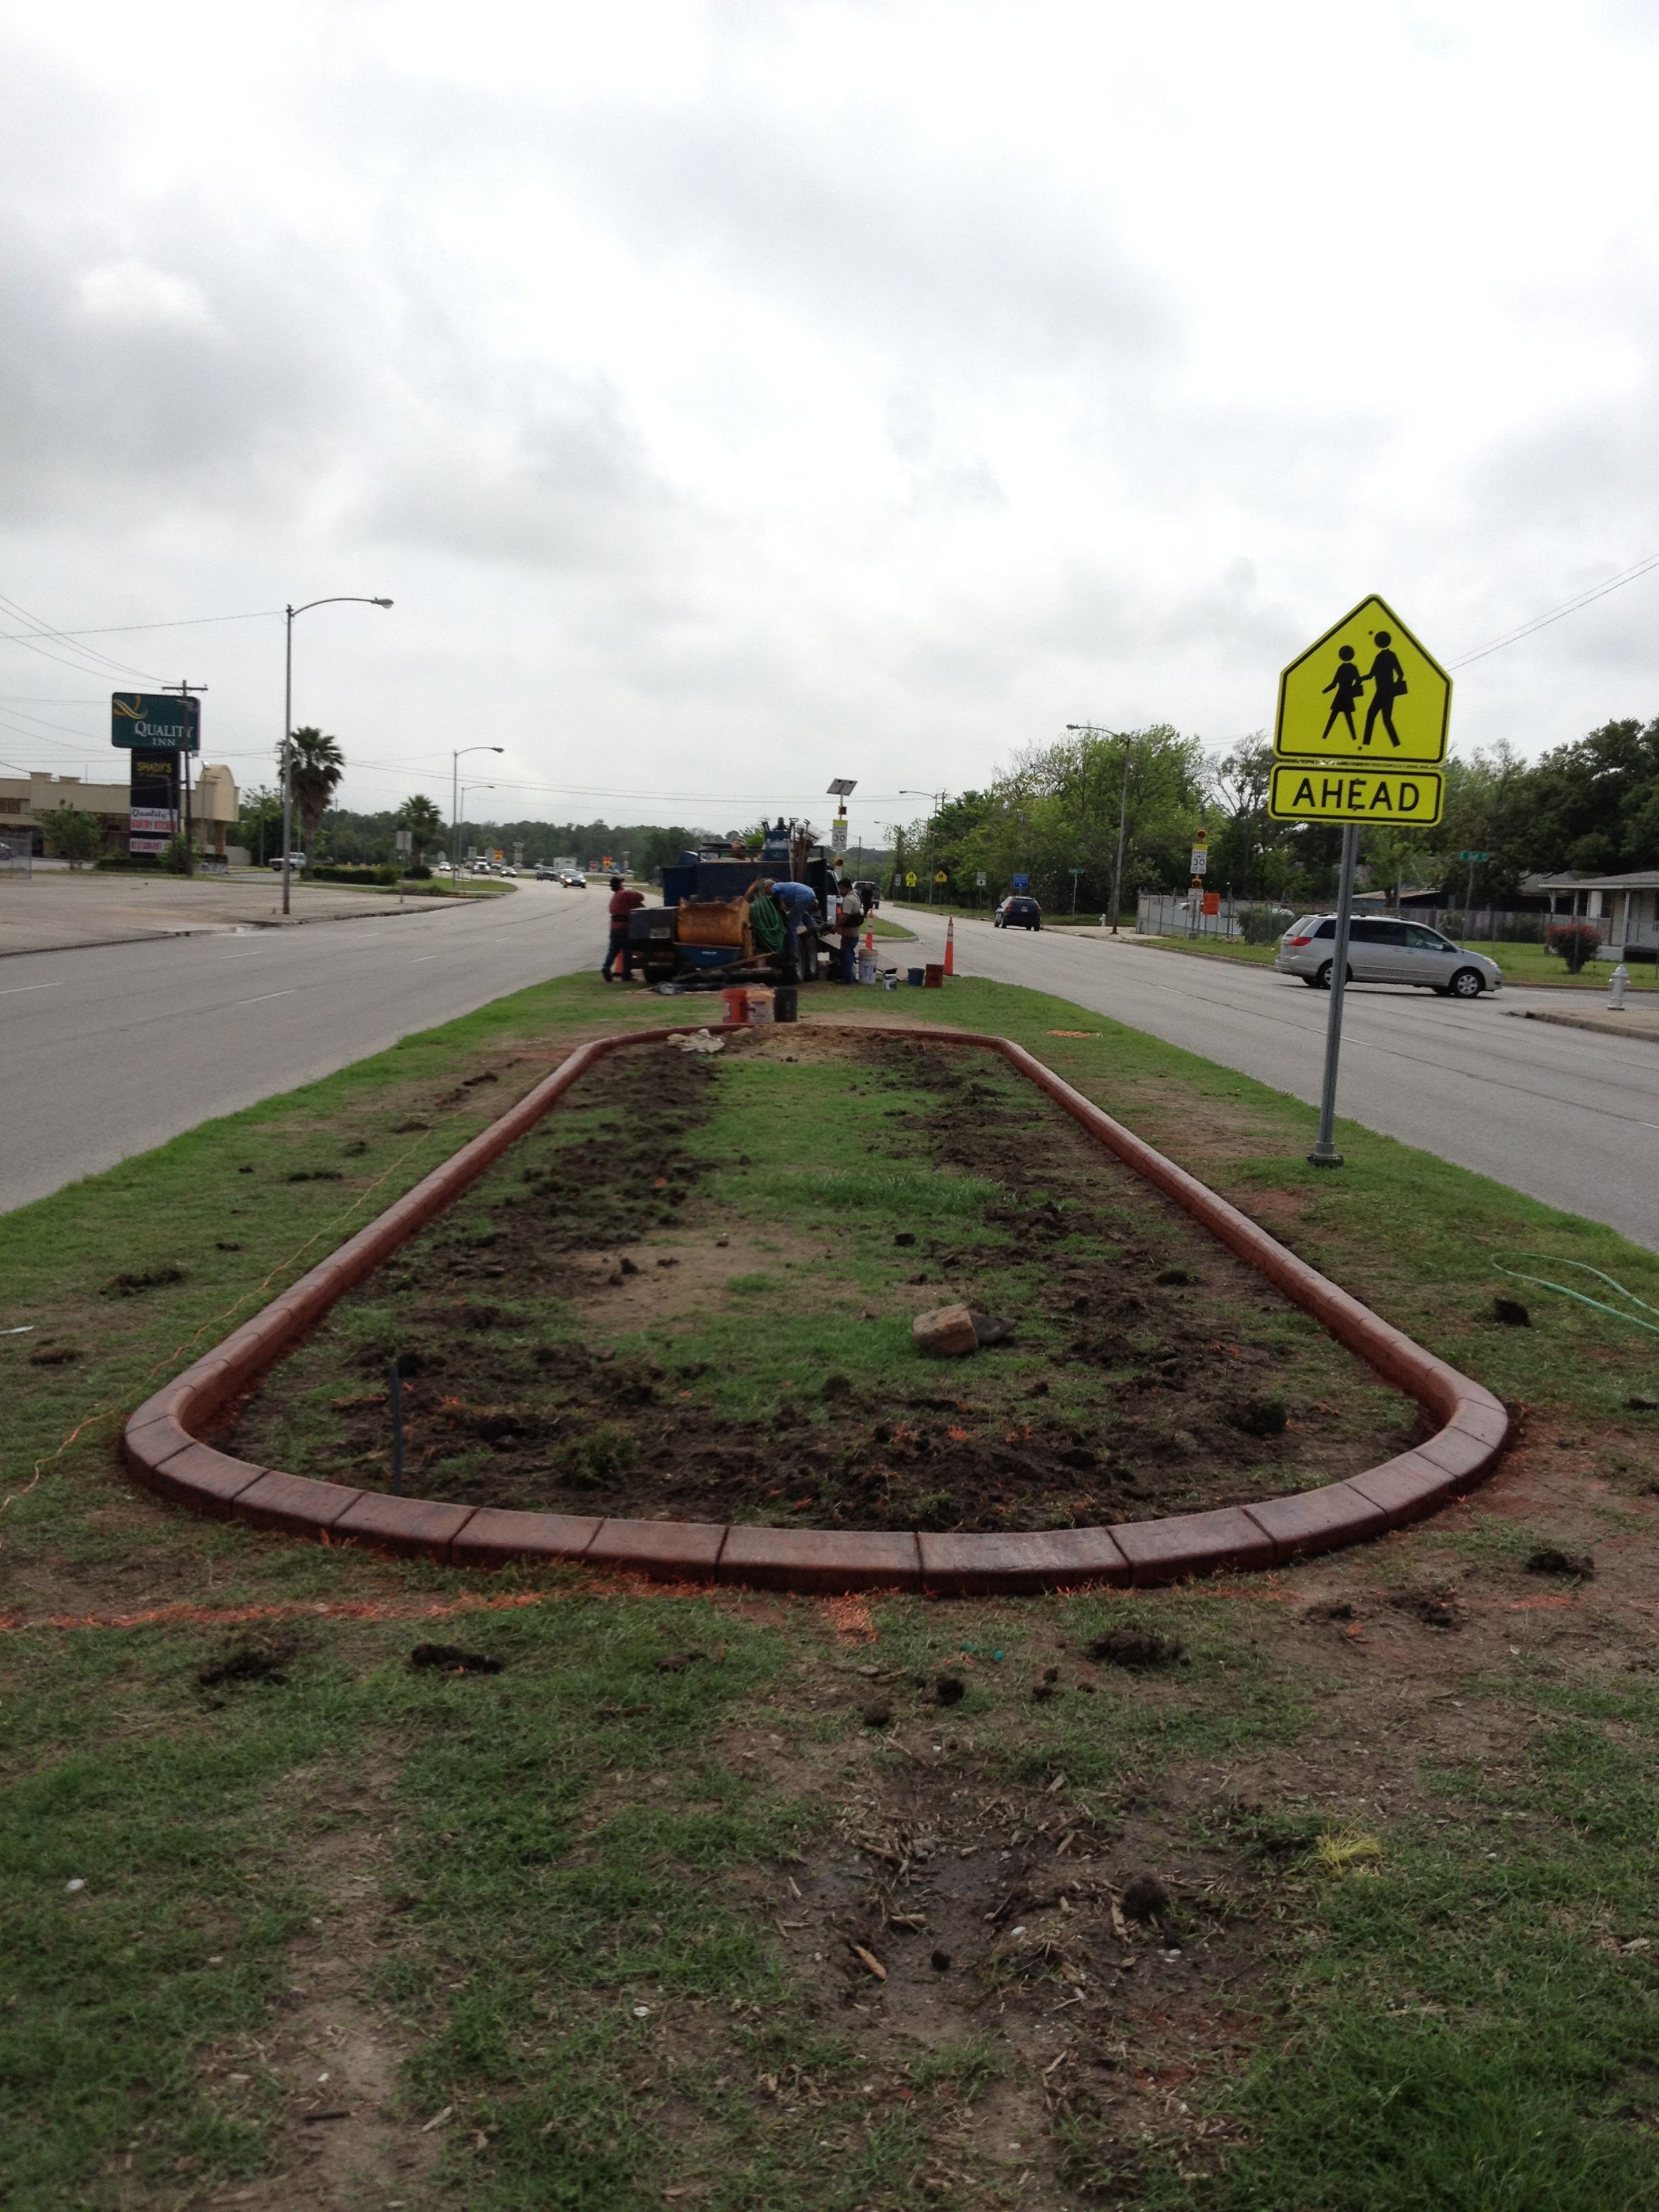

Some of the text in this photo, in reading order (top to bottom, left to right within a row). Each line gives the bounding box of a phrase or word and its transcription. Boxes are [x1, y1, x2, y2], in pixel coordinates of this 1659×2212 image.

[135, 720, 194, 738] QUALITY
[152, 737, 176, 746] INN
[1292, 777, 1420, 812] AHEAD
[132, 808, 167, 819] Quality
[1193, 858, 1205, 866] 30
